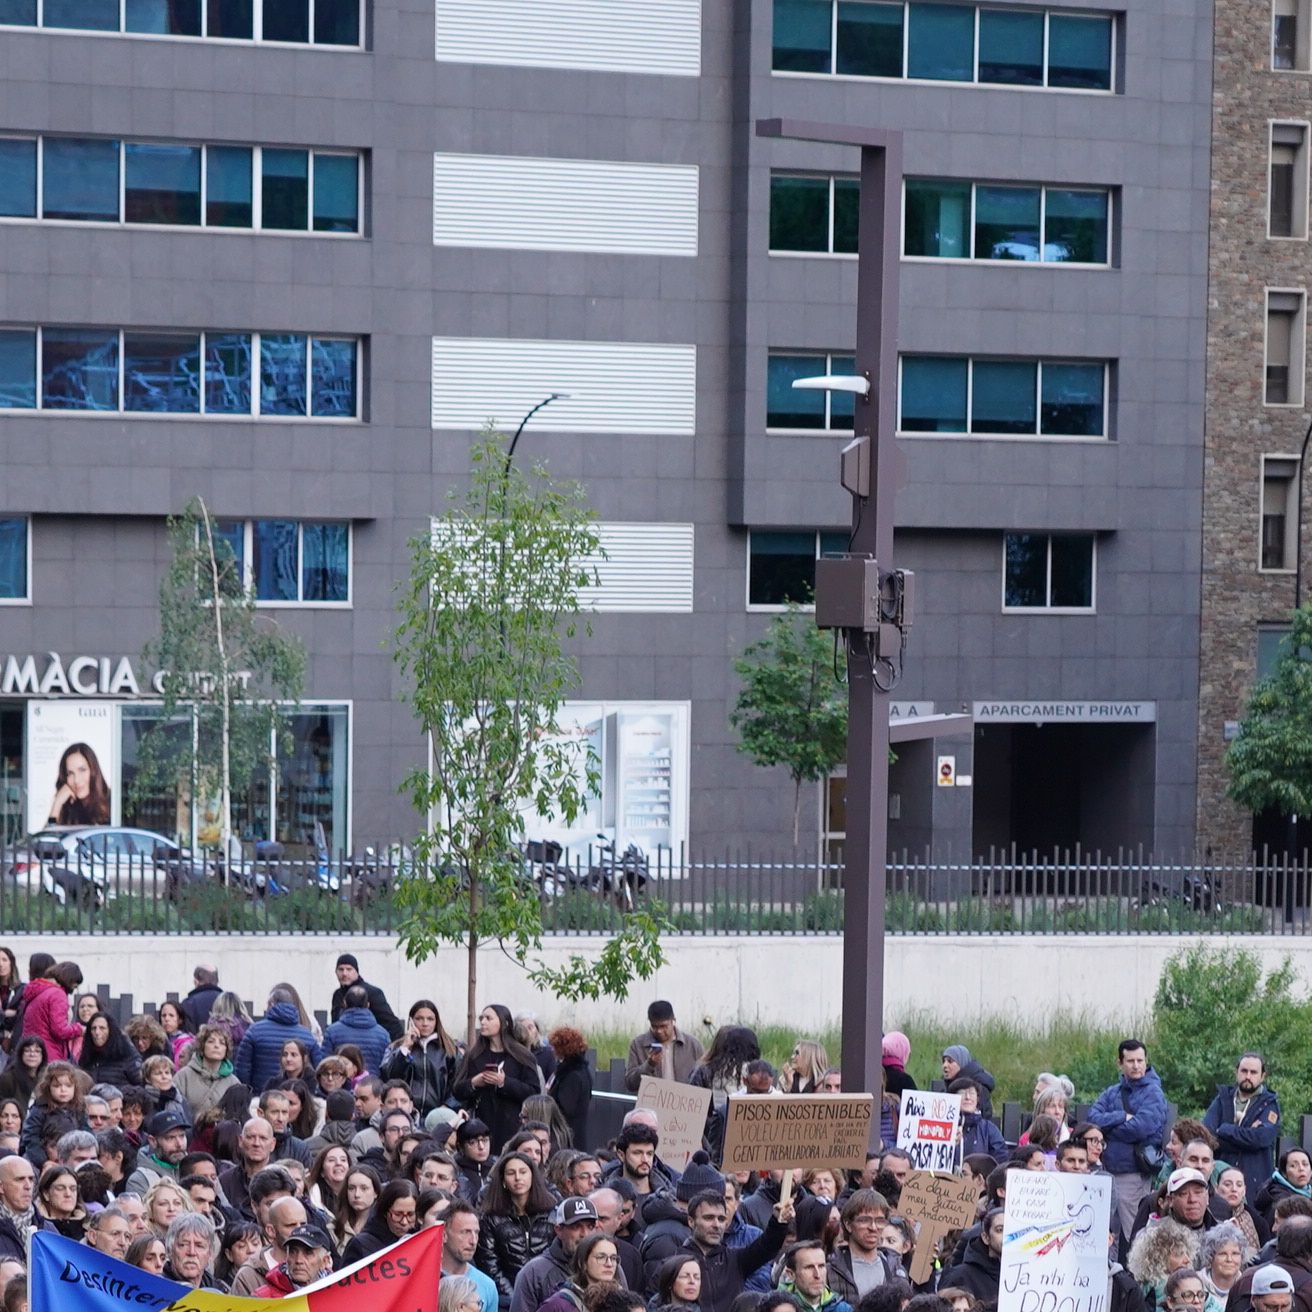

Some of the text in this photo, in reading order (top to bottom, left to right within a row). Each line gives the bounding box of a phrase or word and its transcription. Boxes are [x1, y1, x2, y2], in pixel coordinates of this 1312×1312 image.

[980, 704, 1142, 717] APARCAMENT PRIVAT
[641, 1082, 703, 1115] ANDORRA
[735, 1103, 871, 1121] PISOS INSOSTENIBLES
[932, 1098, 947, 1120] NO
[740, 1122, 828, 1143] VOLEU FER FORA
[733, 1145, 762, 1164] GENT
[764, 1144, 821, 1163] TREBALLADORA
[903, 1172, 921, 1191] La
[956, 1185, 977, 1205] del
[905, 1194, 965, 1214] meu futur
[905, 1207, 914, 1215] a
[1004, 1262, 1090, 1293] Ja n'hi ha
